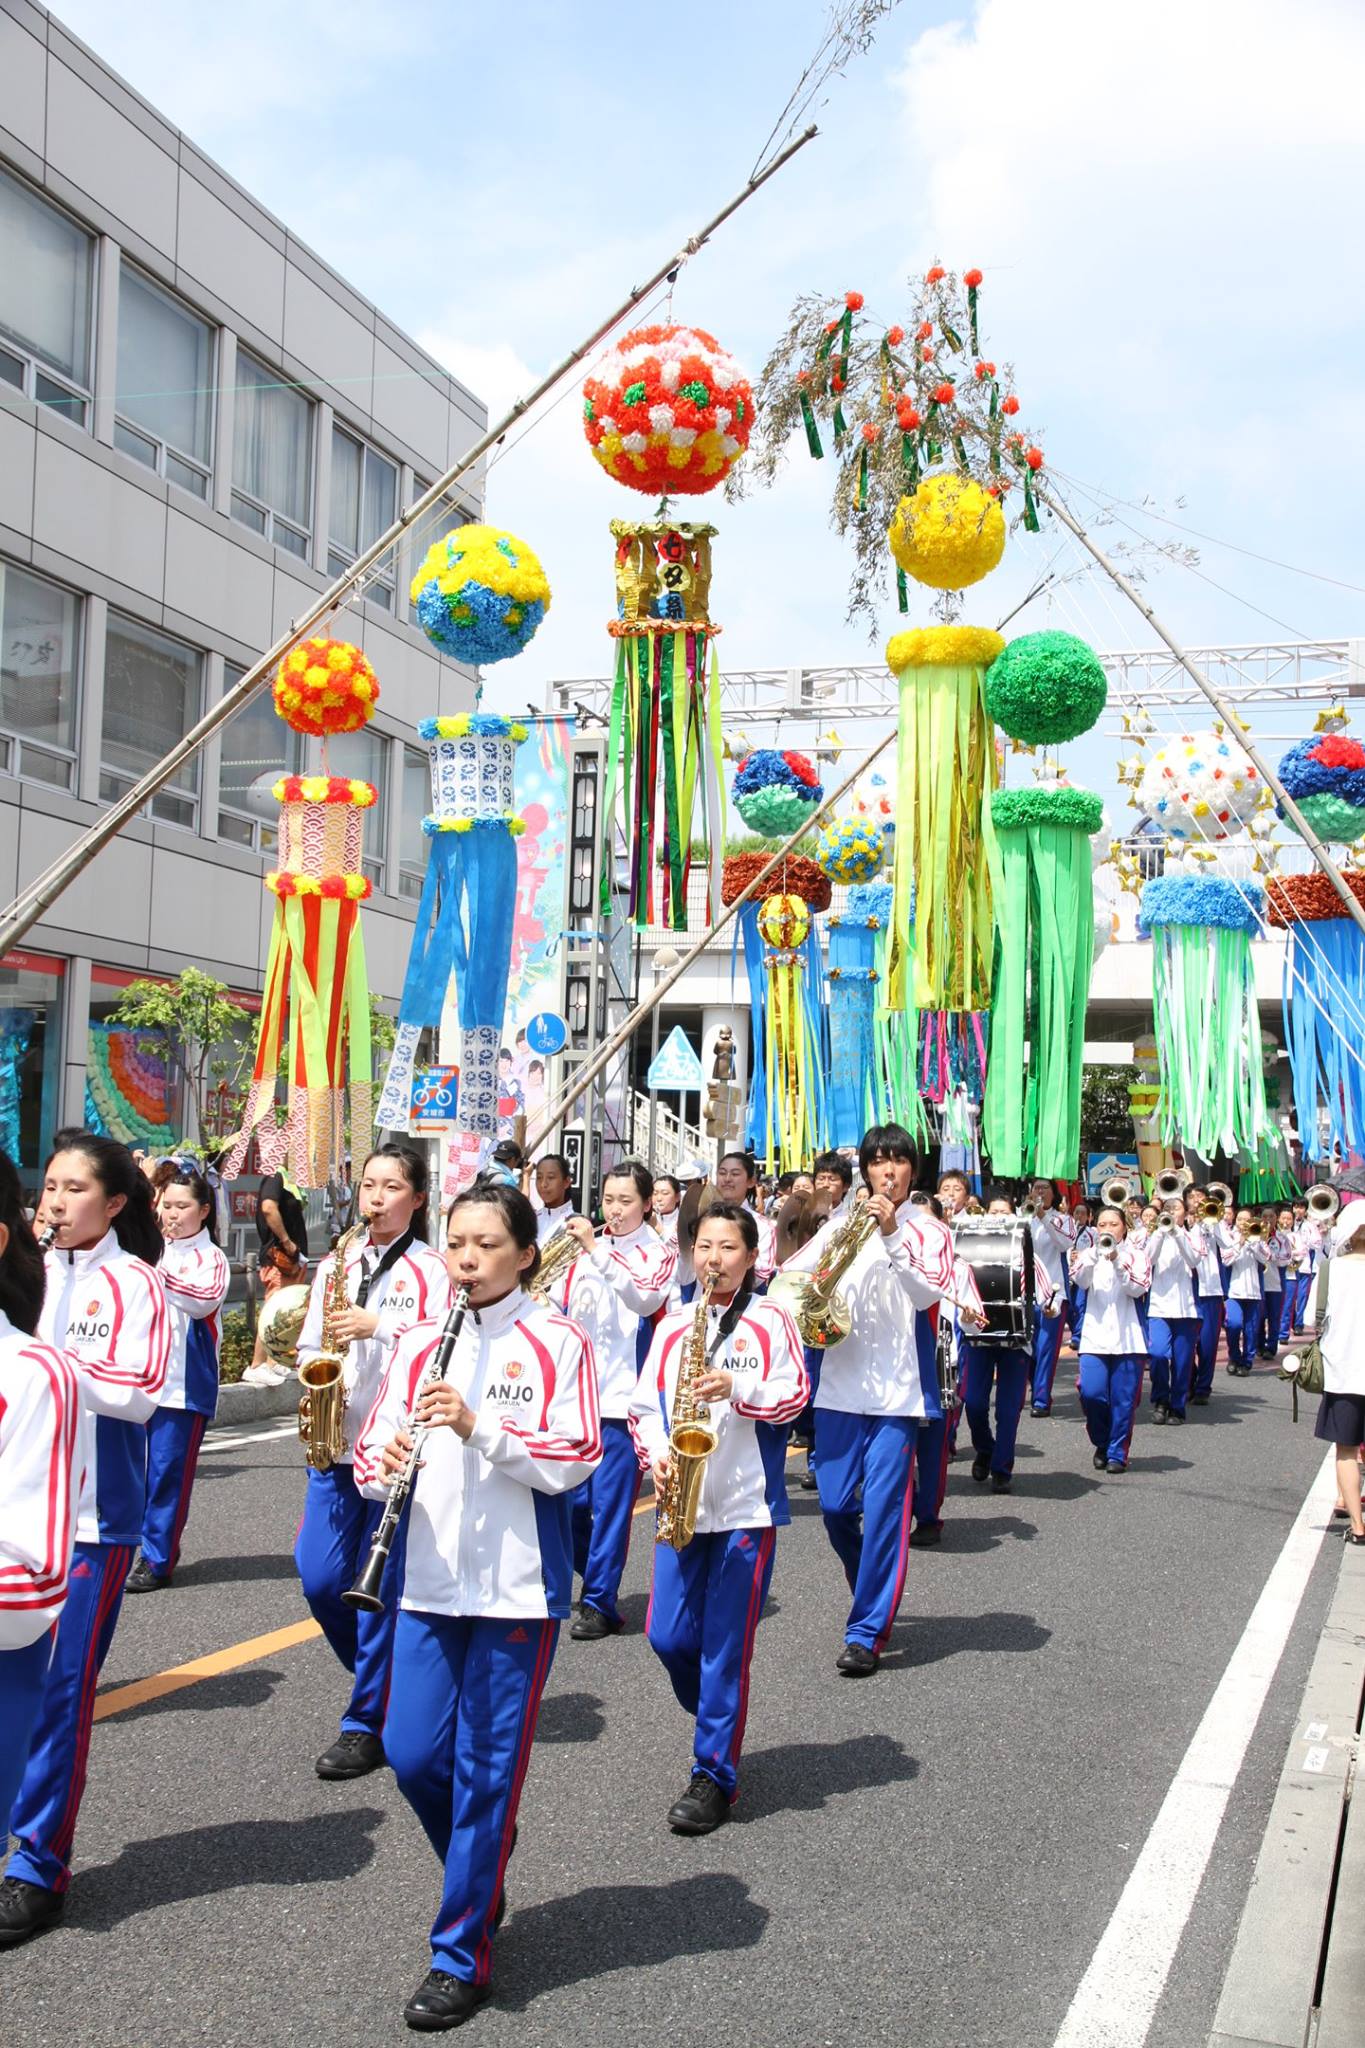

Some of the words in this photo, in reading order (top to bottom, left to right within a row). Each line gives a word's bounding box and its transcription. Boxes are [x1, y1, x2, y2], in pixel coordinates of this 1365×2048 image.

[380, 1297, 415, 1309] ANJO
[65, 1321, 110, 1338] ANJO
[721, 1357, 759, 1370] ANJO
[486, 1384, 533, 1402] ANJO
